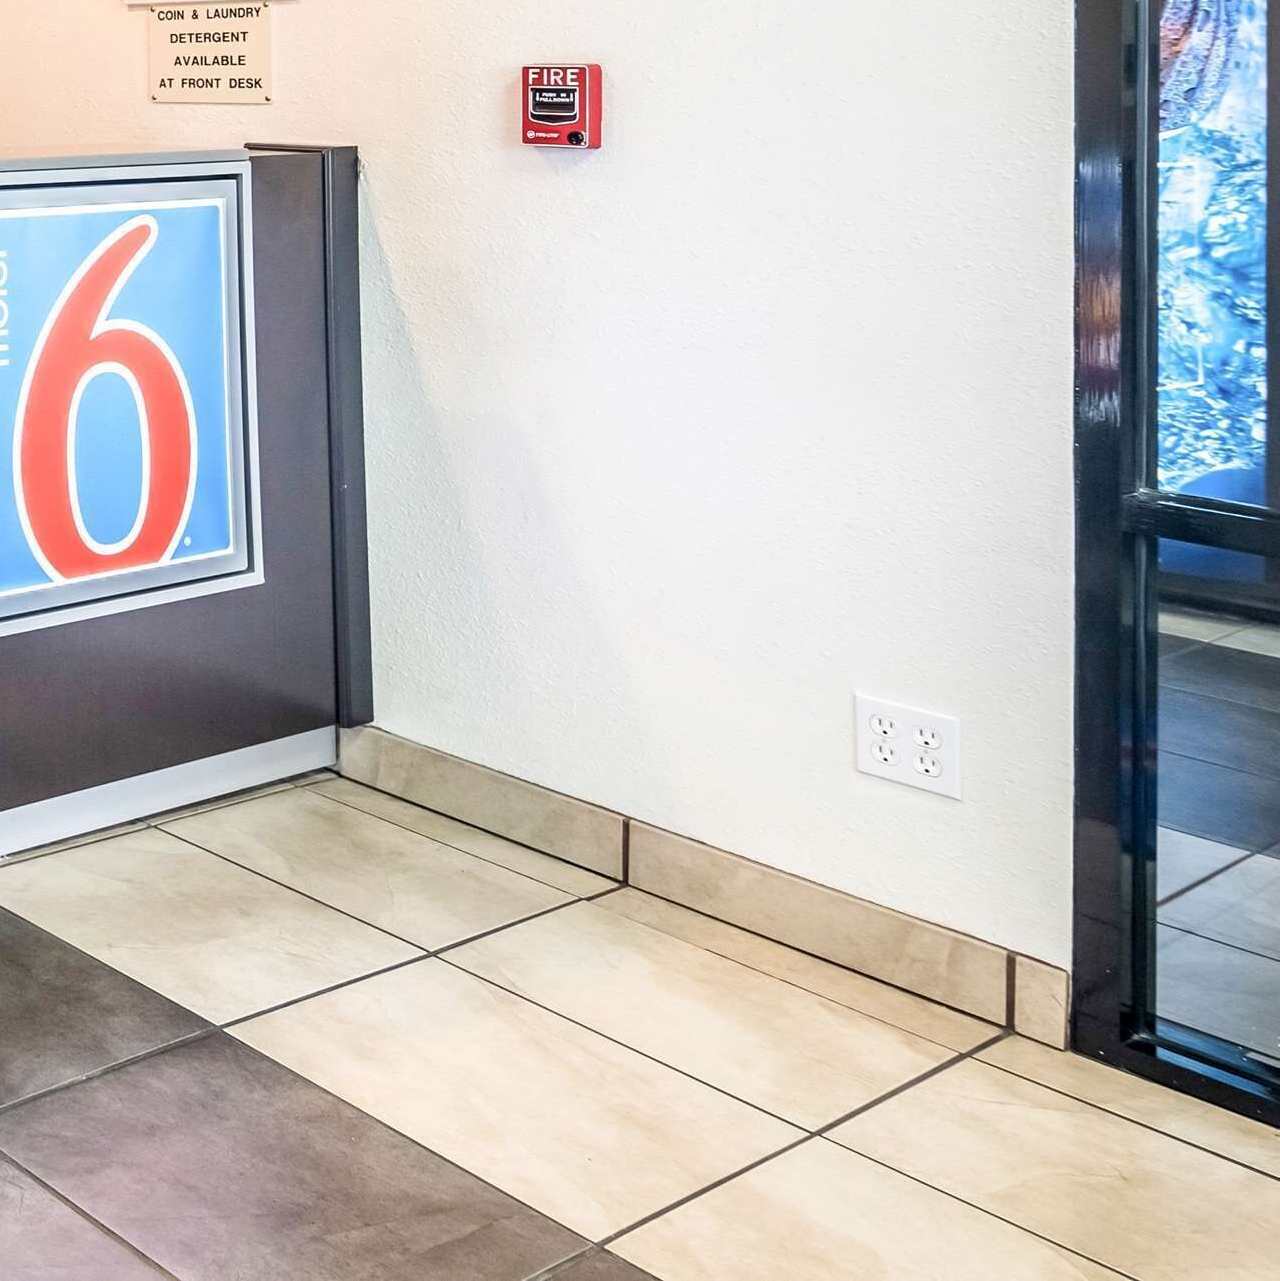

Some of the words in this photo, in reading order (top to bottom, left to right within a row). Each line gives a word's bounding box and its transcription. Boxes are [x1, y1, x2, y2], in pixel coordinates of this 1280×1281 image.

[157, 10, 185, 21] COIN
[191, 9, 198, 19] &
[206, 7, 261, 19] LAUNDRY
[170, 31, 248, 43] DETERGENT
[174, 55, 246, 66] AVAILABLE
[159, 78, 174, 88] AT
[181, 78, 221, 88] FRONT
[229, 78, 262, 89] DESK
[529, 69, 579, 85] FIRE
[13, 214, 198, 584] 6
